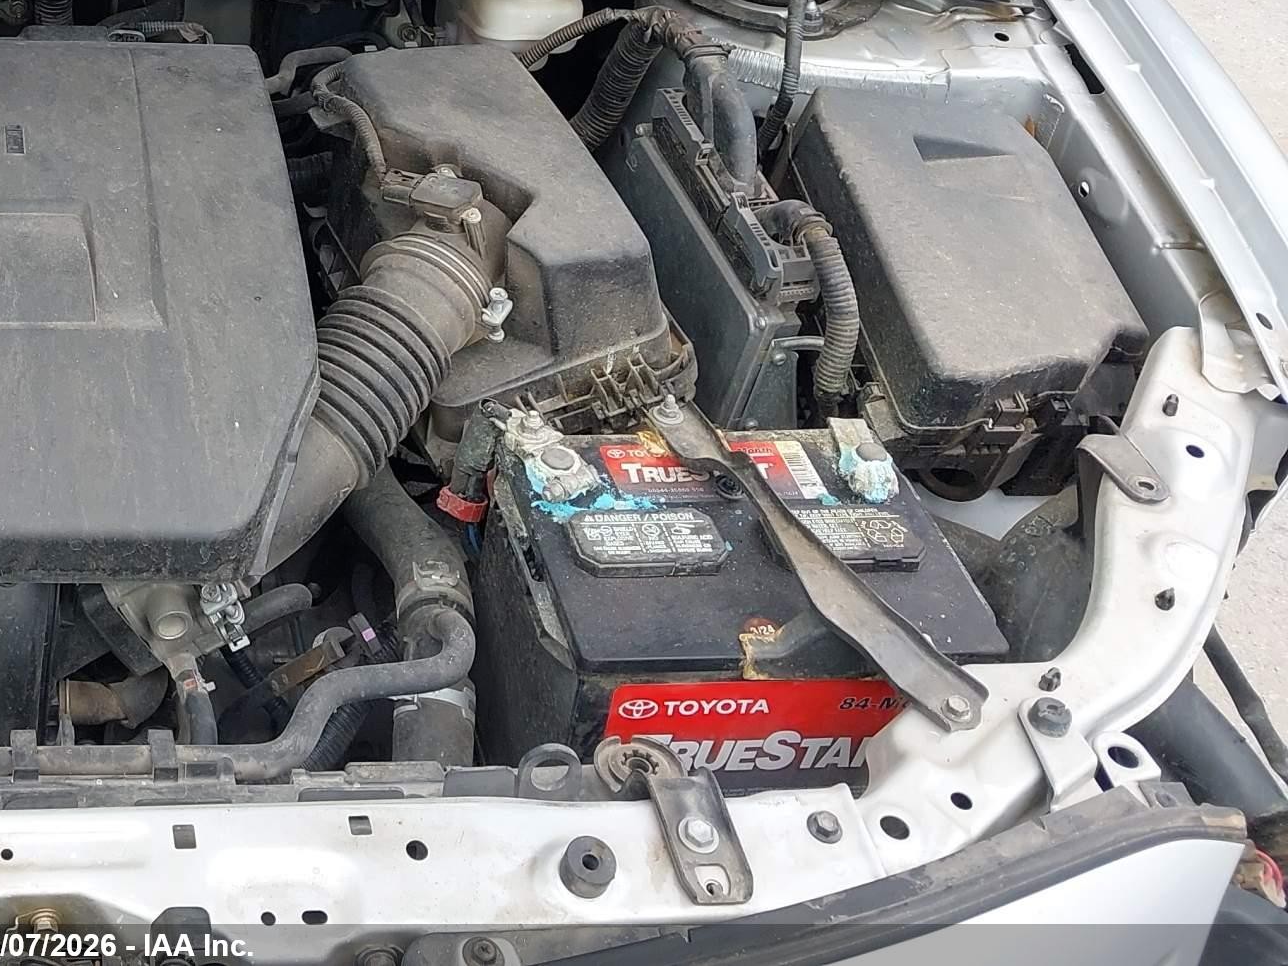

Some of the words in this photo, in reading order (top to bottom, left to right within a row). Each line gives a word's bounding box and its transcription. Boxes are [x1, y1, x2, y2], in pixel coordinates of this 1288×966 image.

[594, 514, 641, 522] DANGER
[652, 513, 694, 521] POISON
[664, 699, 770, 716] TOYOTA
